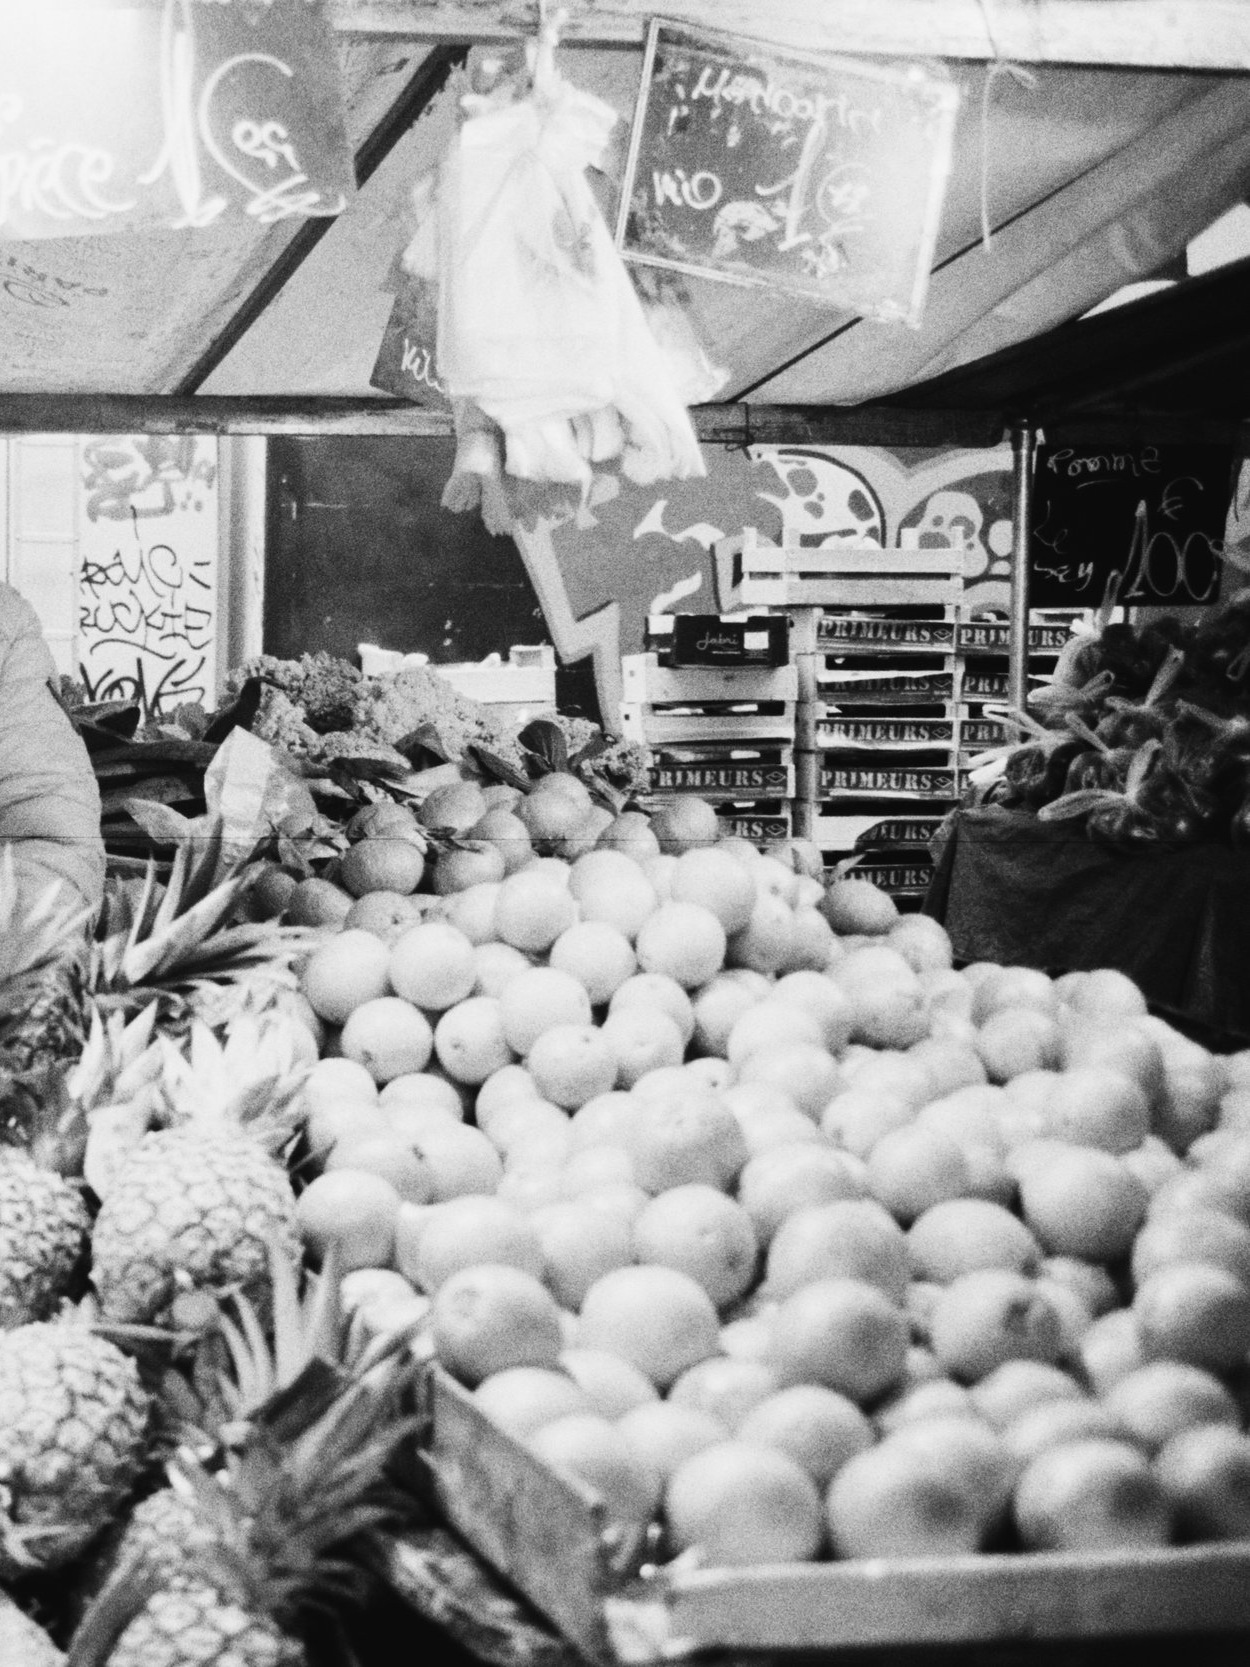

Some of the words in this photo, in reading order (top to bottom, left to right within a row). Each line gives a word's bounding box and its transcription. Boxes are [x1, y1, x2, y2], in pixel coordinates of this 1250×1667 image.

[819, 620, 931, 643] PRIMEURS
[961, 629, 1068, 648] PRIMURS
[821, 770, 932, 790] PRIMEURS
